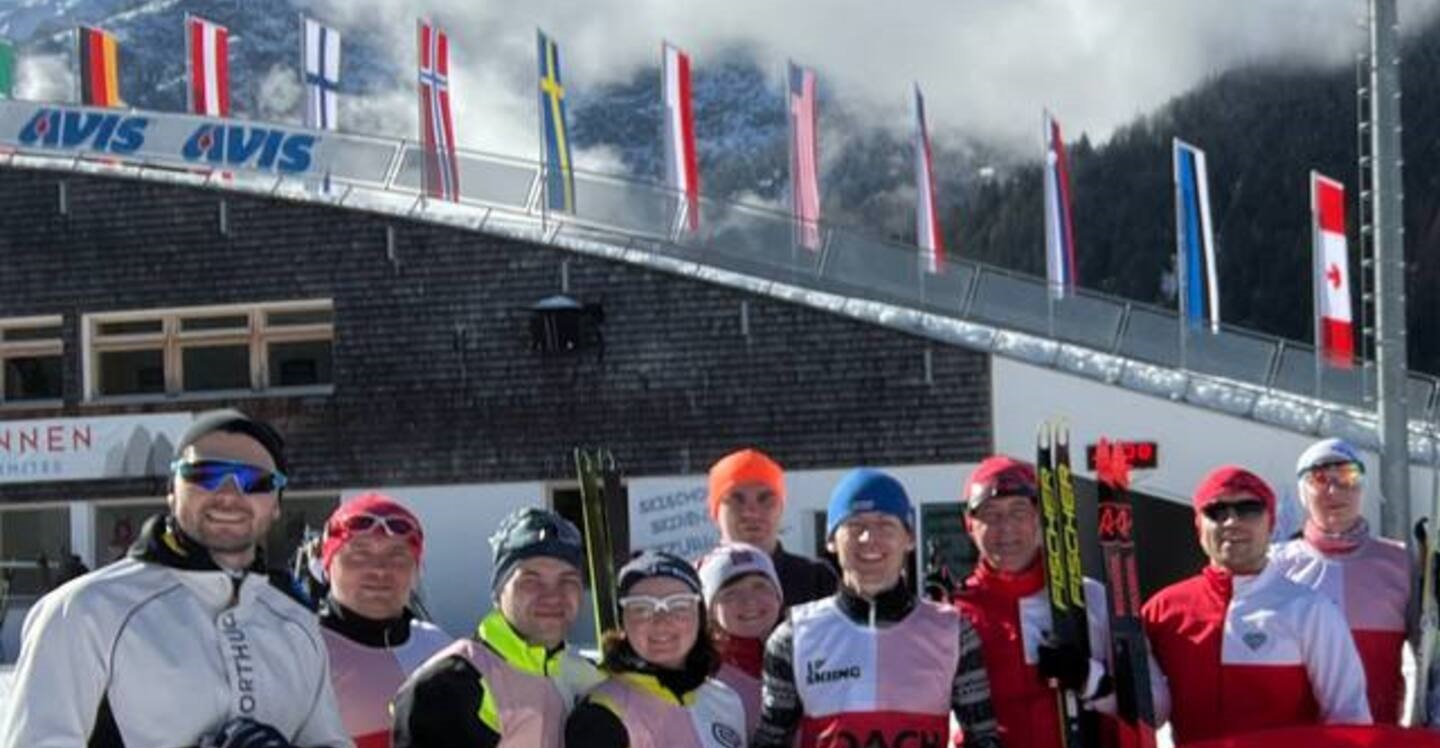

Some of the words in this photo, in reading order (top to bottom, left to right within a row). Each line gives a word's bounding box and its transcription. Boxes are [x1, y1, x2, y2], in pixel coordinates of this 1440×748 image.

[18, 108, 148, 154] AVIS
[182, 122, 316, 174] AVIS
[1041, 467, 1068, 611] FISCHER
[1057, 463, 1086, 608] FISCHER
[221, 611, 256, 714] ORTHUG
